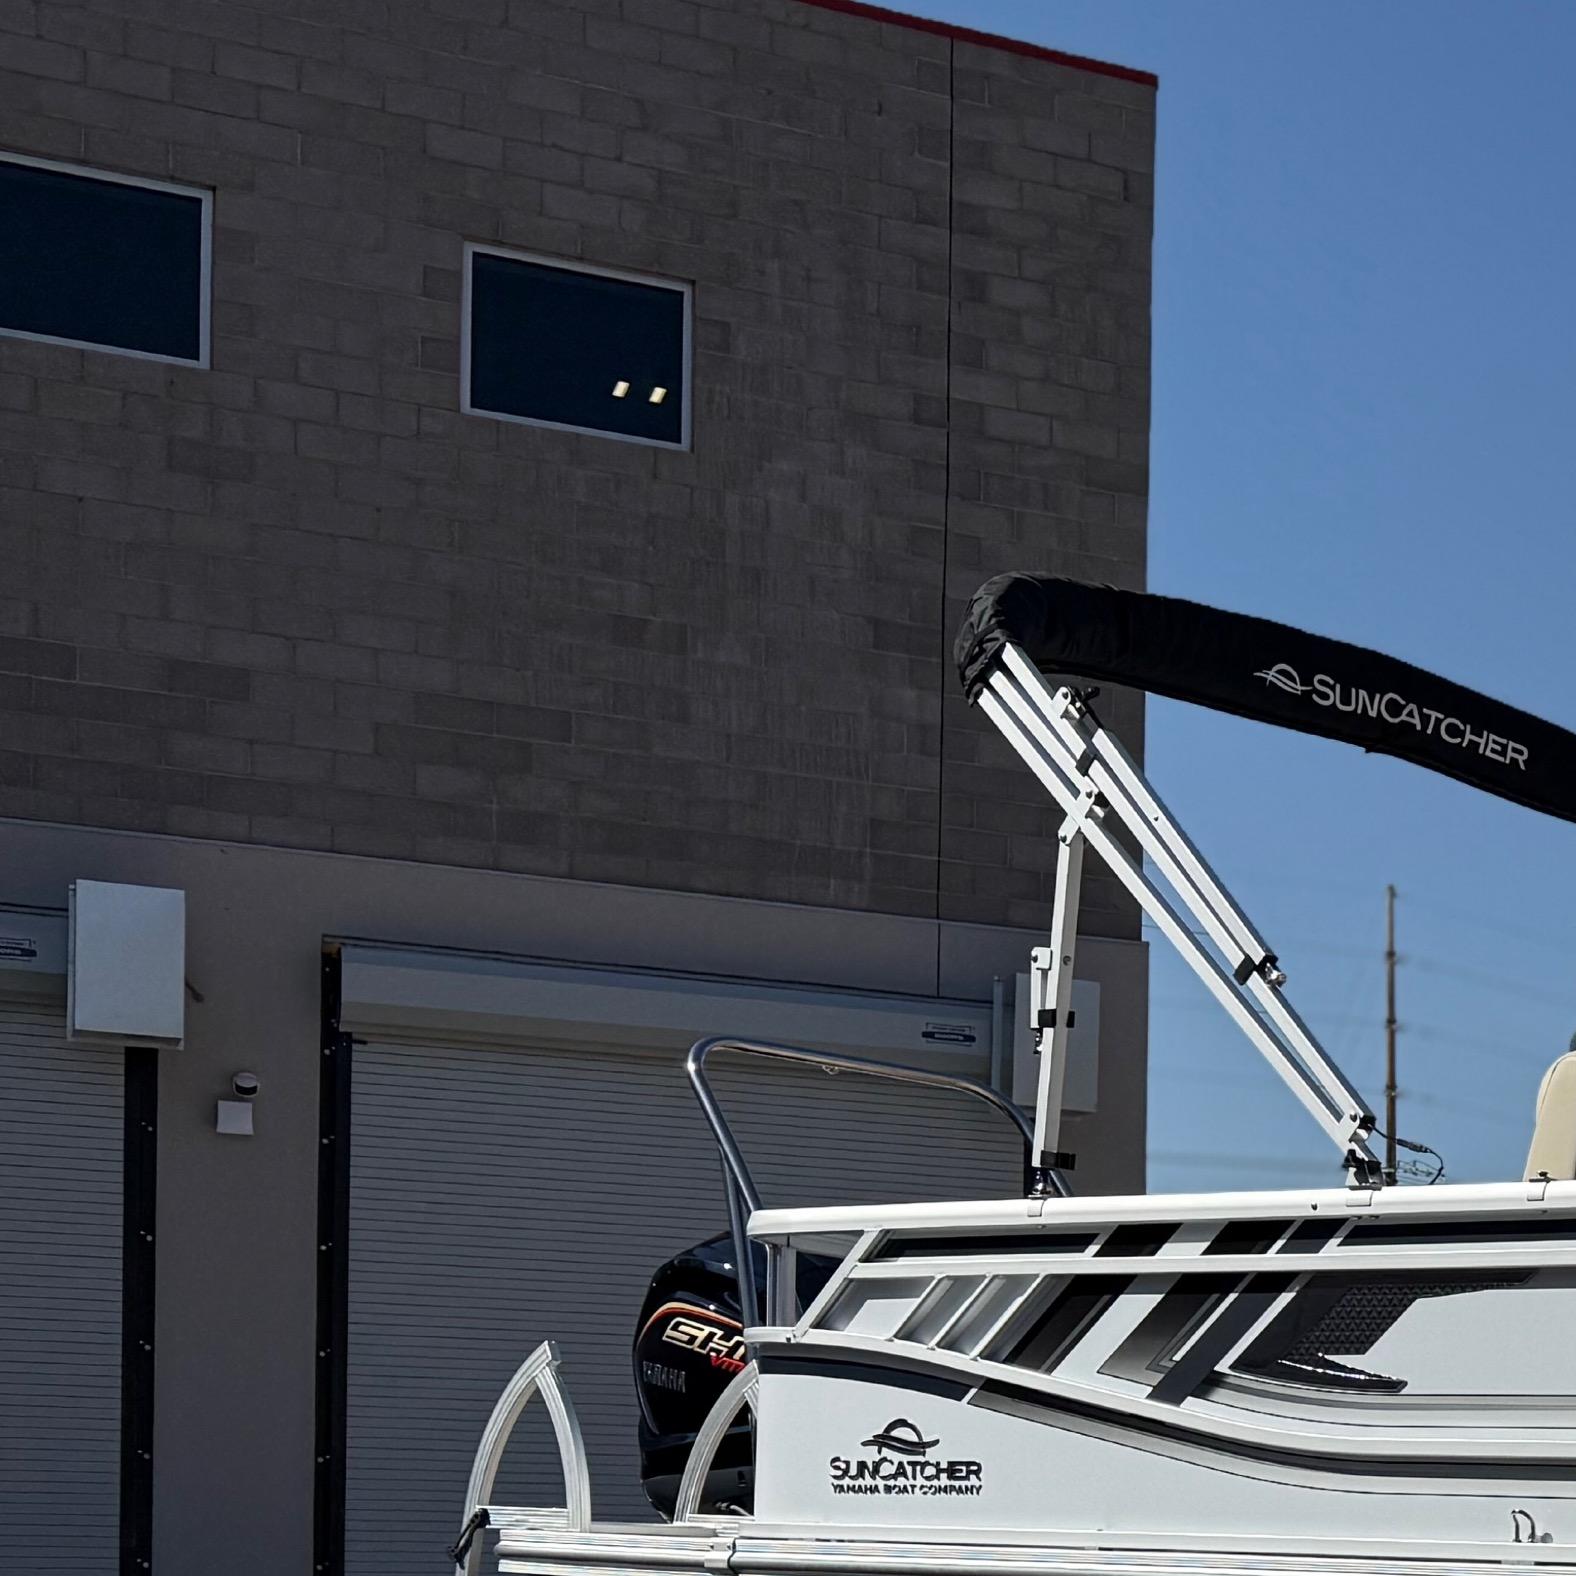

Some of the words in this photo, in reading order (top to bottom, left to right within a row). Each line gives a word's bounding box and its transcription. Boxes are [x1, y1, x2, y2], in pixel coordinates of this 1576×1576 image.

[1312, 674, 1529, 770] SUNCATCHER
[829, 1456, 982, 1482] SUNCATCHER
[831, 1482, 880, 1495] YAMAHA
[883, 1483, 917, 1496] BOAT
[919, 1483, 983, 1496] COMPANY
